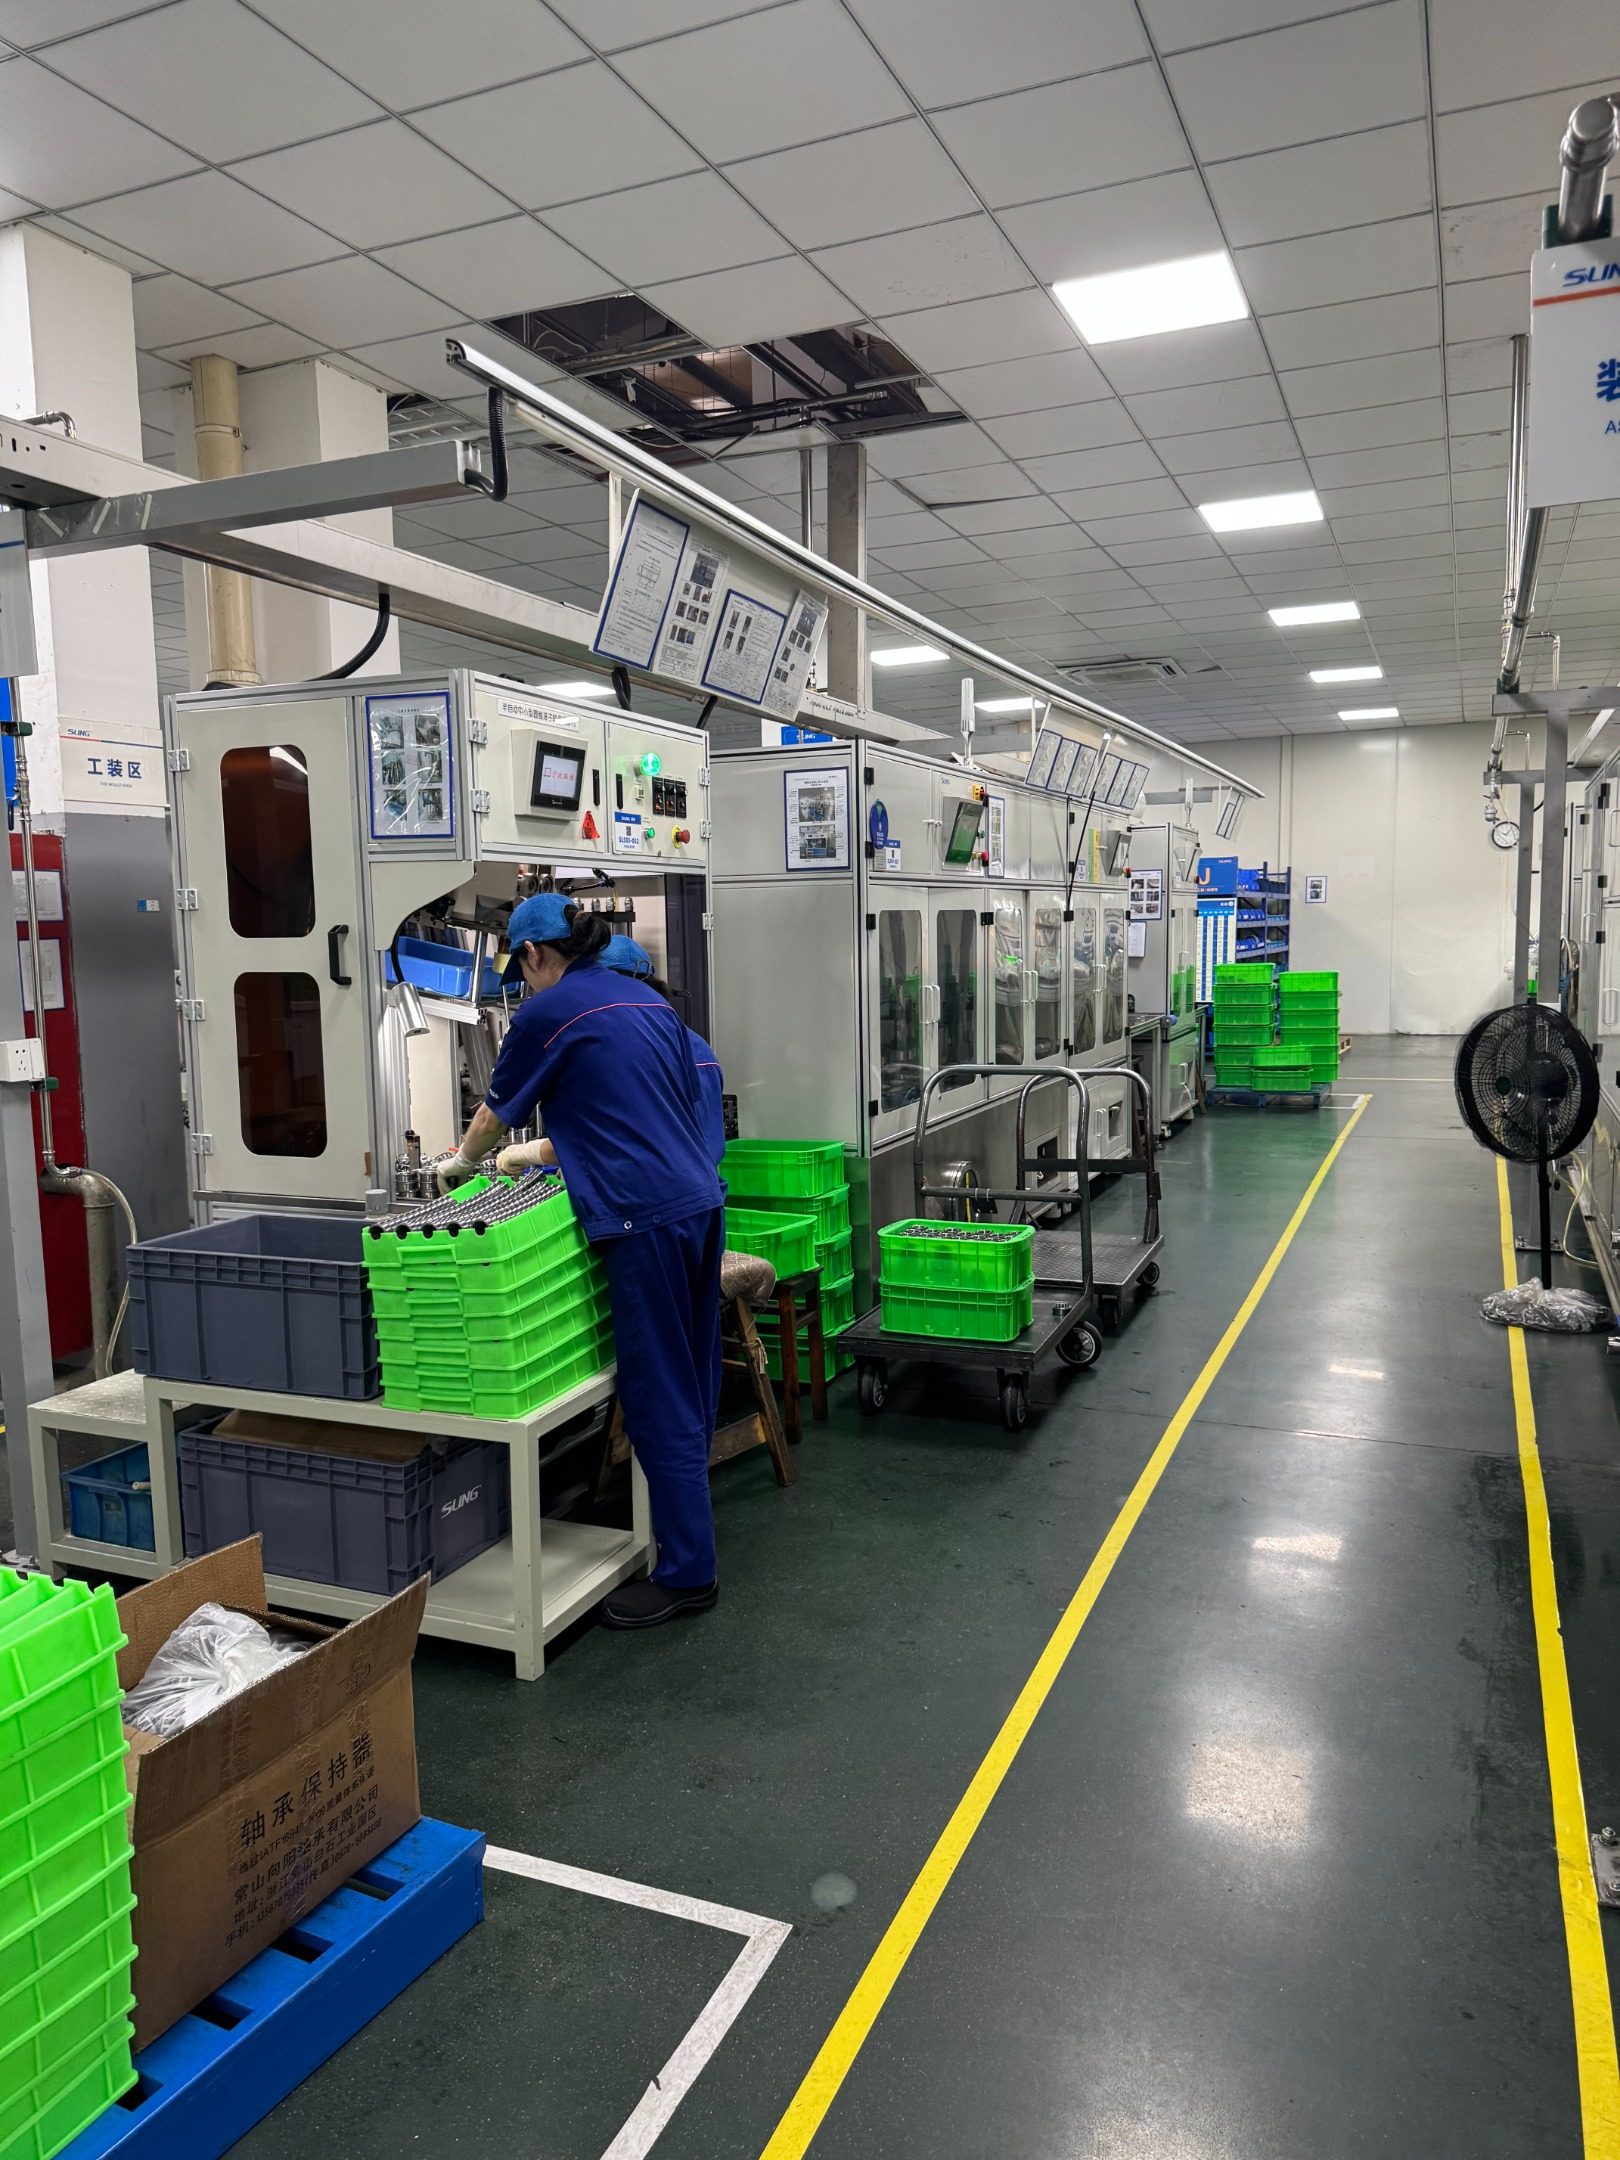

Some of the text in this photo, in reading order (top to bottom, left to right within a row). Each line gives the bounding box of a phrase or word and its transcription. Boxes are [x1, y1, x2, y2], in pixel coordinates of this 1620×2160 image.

[87, 757, 141, 779] 工装区
[440, 1484, 482, 1519] SLING
[240, 1731, 371, 1848] 轴承保持器
